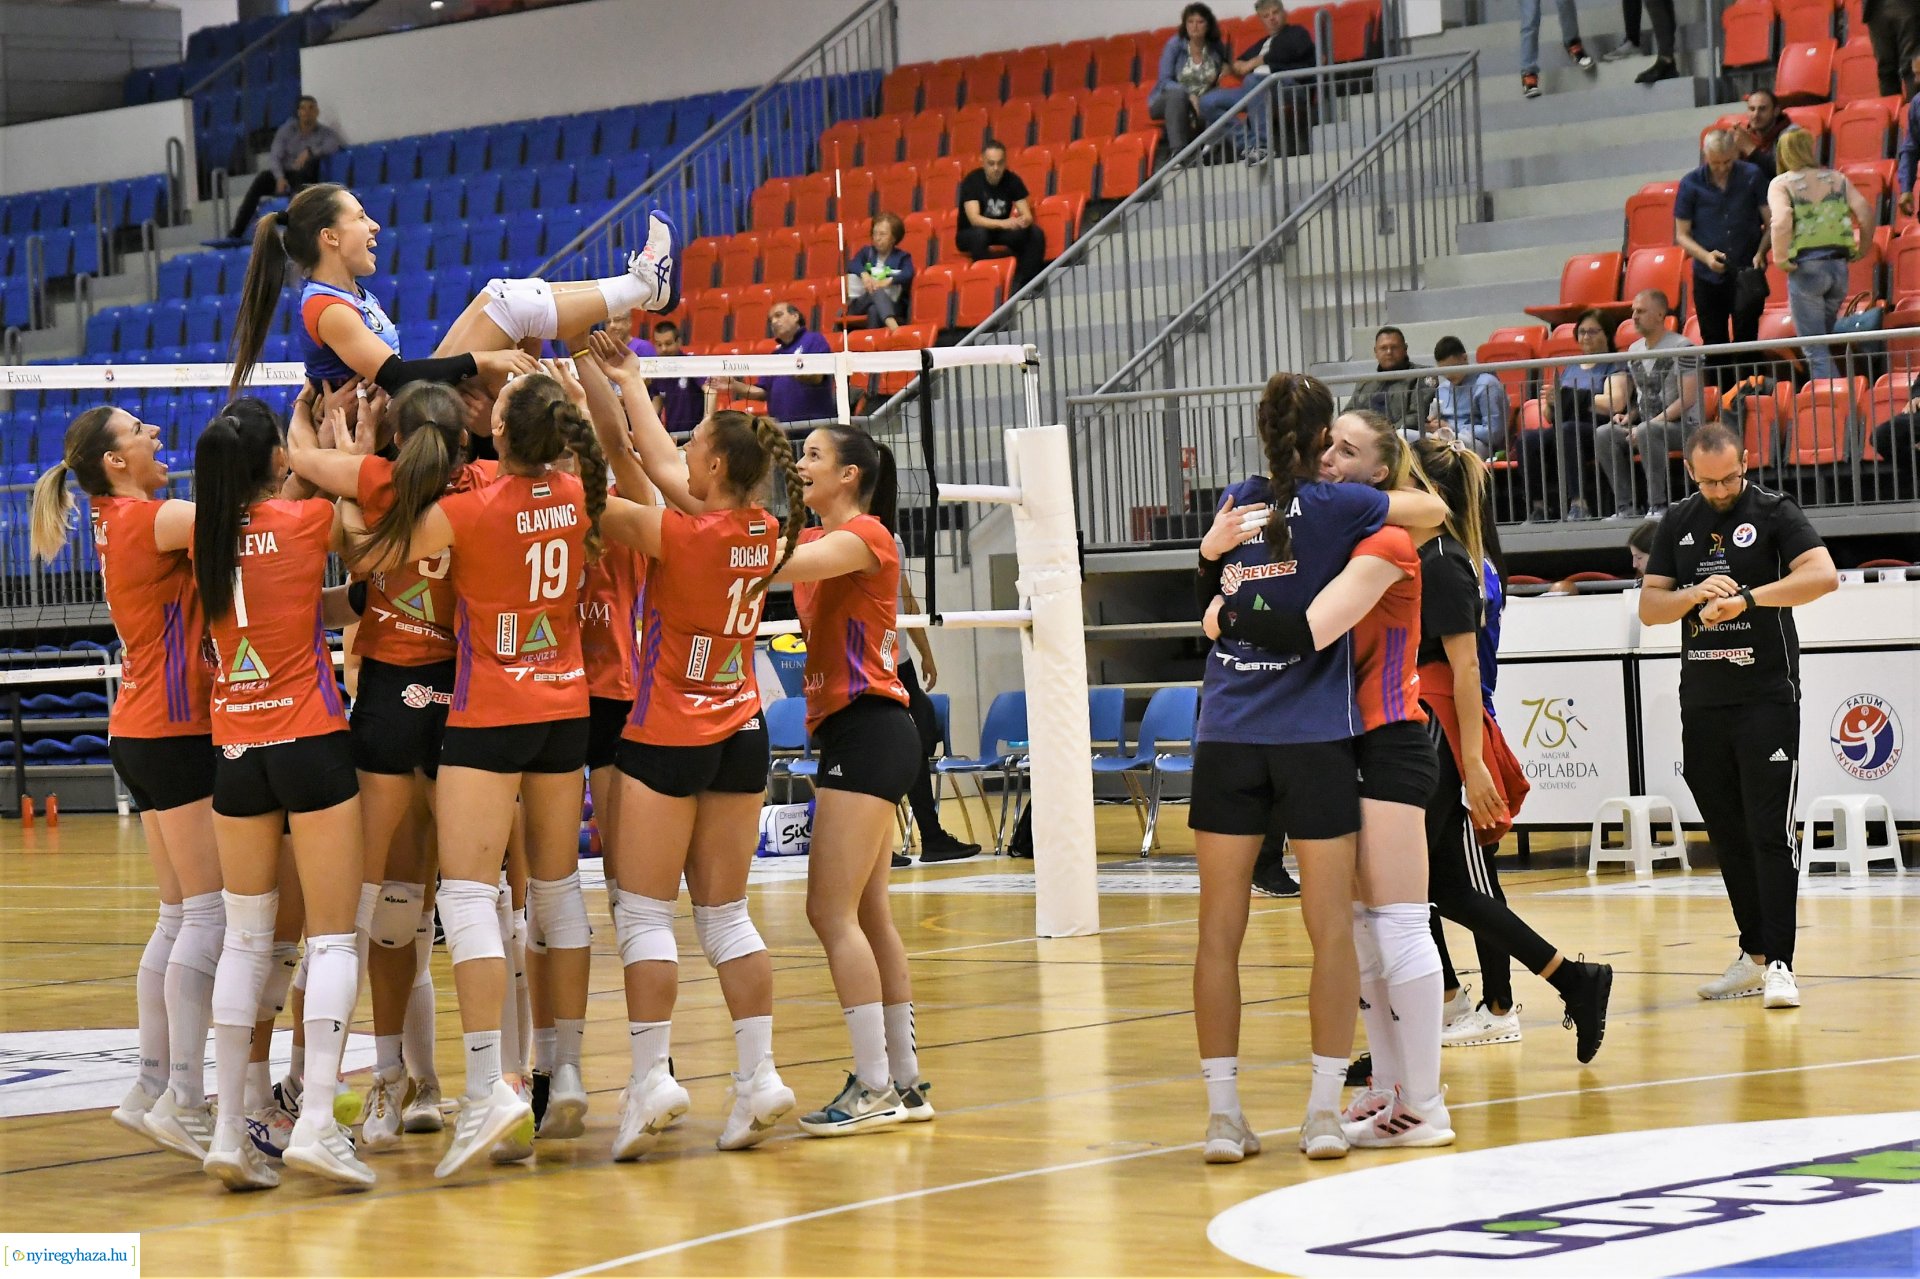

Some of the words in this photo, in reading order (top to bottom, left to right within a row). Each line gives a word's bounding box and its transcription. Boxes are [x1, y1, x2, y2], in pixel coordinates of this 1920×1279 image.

[516, 503, 578, 534] GLAVINIC
[237, 531, 279, 556] LEVA
[730, 543, 769, 568] BOGÁR
[525, 538, 569, 602] 19
[723, 577, 763, 635] 13
[503, 614, 512, 653] STRABAG
[692, 638, 706, 678] STRABAG
[226, 697, 294, 712] BESTRONG
[1846, 696, 1883, 709] FATUM
